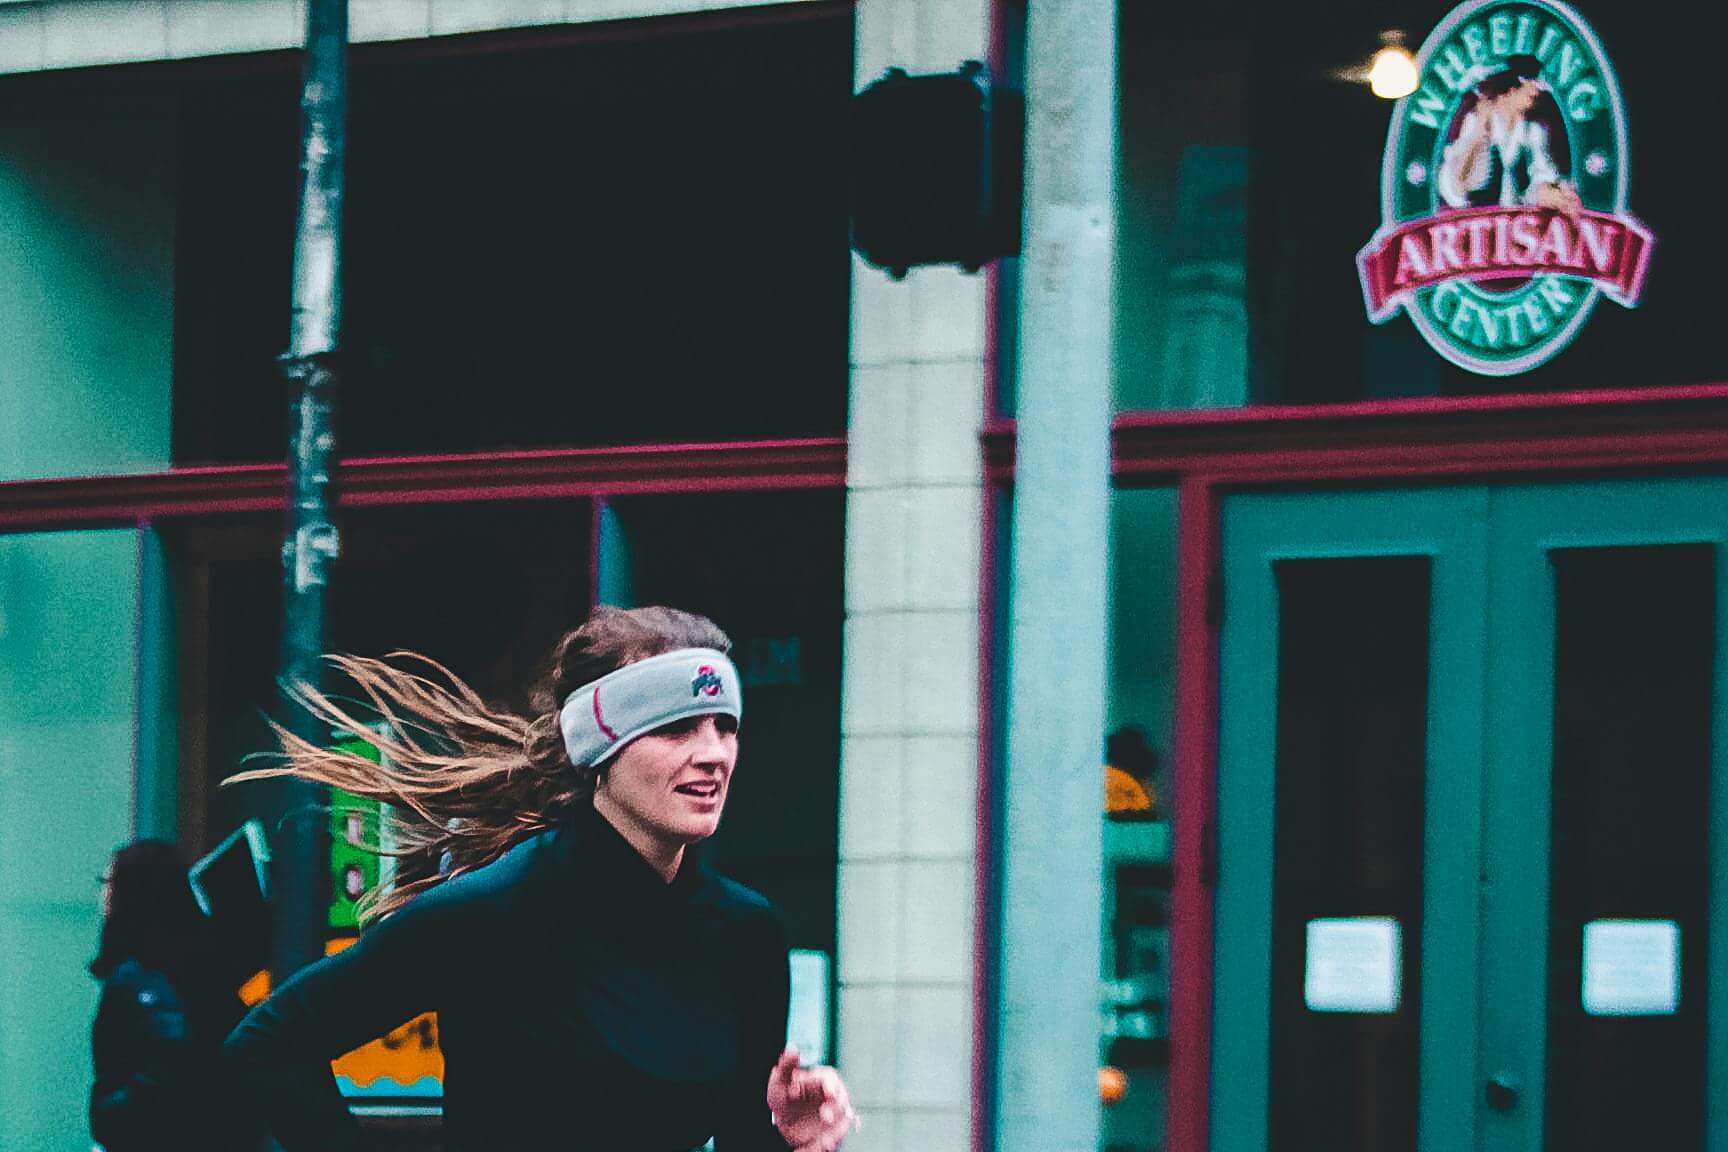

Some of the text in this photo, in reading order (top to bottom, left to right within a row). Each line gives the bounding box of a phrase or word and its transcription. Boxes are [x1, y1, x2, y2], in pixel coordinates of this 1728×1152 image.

[1410, 13, 1600, 128] WHEELING
[1394, 213, 1621, 286] ARTISAN
[1432, 281, 1574, 345] CENTER
